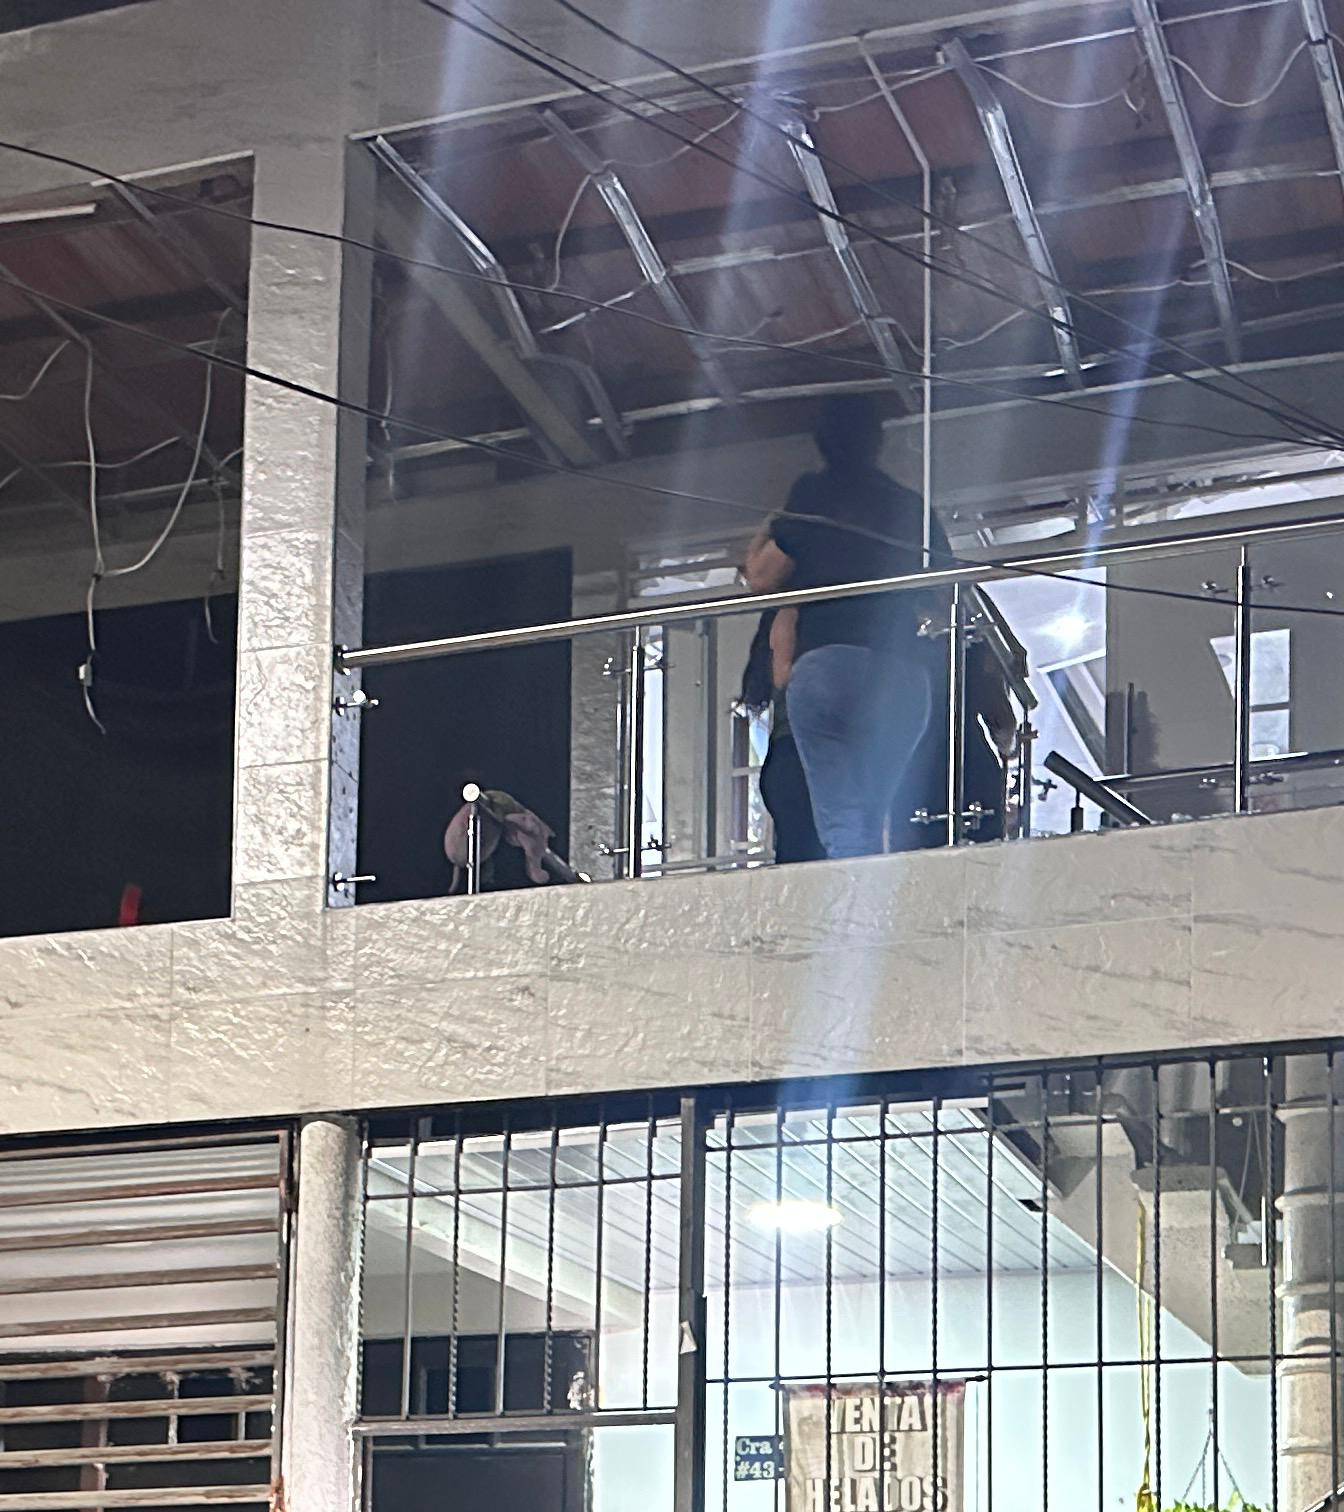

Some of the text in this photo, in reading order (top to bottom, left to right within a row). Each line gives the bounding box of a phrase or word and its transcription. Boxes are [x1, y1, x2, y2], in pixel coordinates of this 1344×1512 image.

[827, 1396, 926, 1433] VENTA
[736, 1438, 773, 1455] Cra
[854, 1434, 897, 1472] DE
